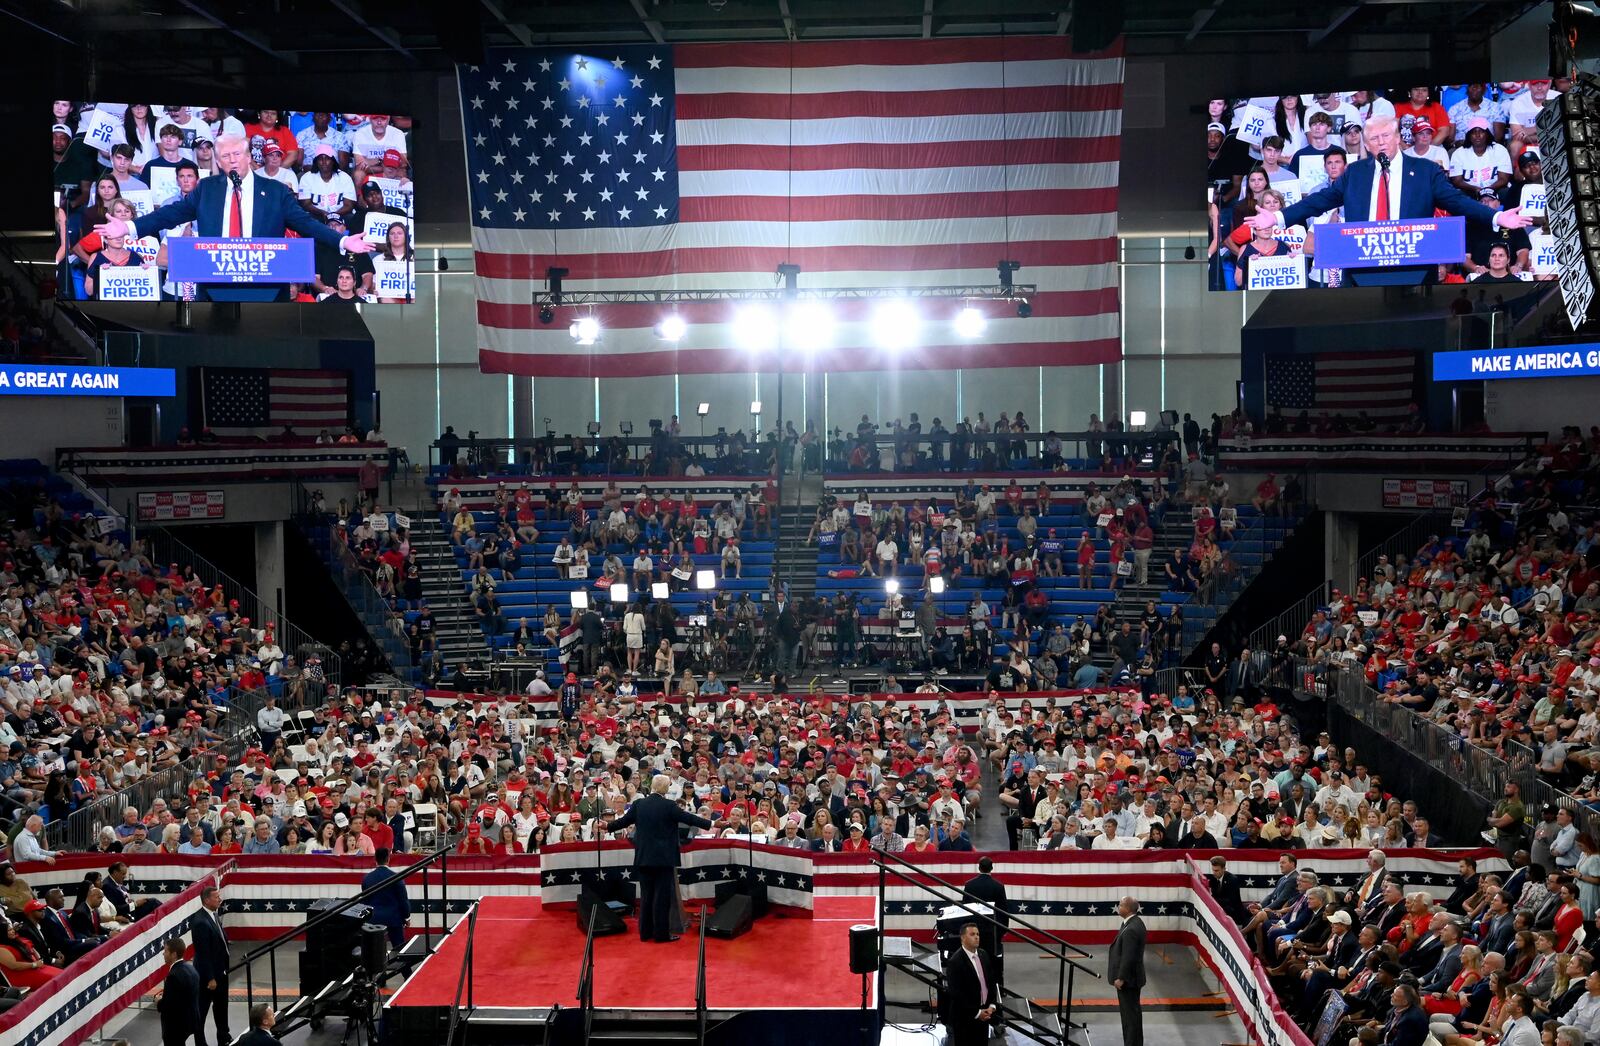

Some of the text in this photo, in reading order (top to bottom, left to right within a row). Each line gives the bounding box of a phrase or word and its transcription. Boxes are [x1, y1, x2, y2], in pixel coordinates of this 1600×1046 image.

[1342, 228, 1363, 236] TEXT
[1363, 226, 1398, 234] GEORGIA
[1353, 231, 1424, 248] TRUMP
[207, 250, 276, 263] TRUMP
[1361, 244, 1417, 257] VANCE
[216, 262, 269, 272] VANCE
[1254, 266, 1297, 277] YOU'RE
[106, 278, 150, 287] YOU'RE
[232, 275, 254, 283] 2024
[1251, 274, 1300, 288] FIRED!
[103, 286, 154, 298] FIRED!
[1471, 355, 1512, 373] MAKE
[1514, 351, 1583, 371] AMERICA
[14, 371, 68, 388] GREAT
[71, 373, 119, 389] AGAIN
